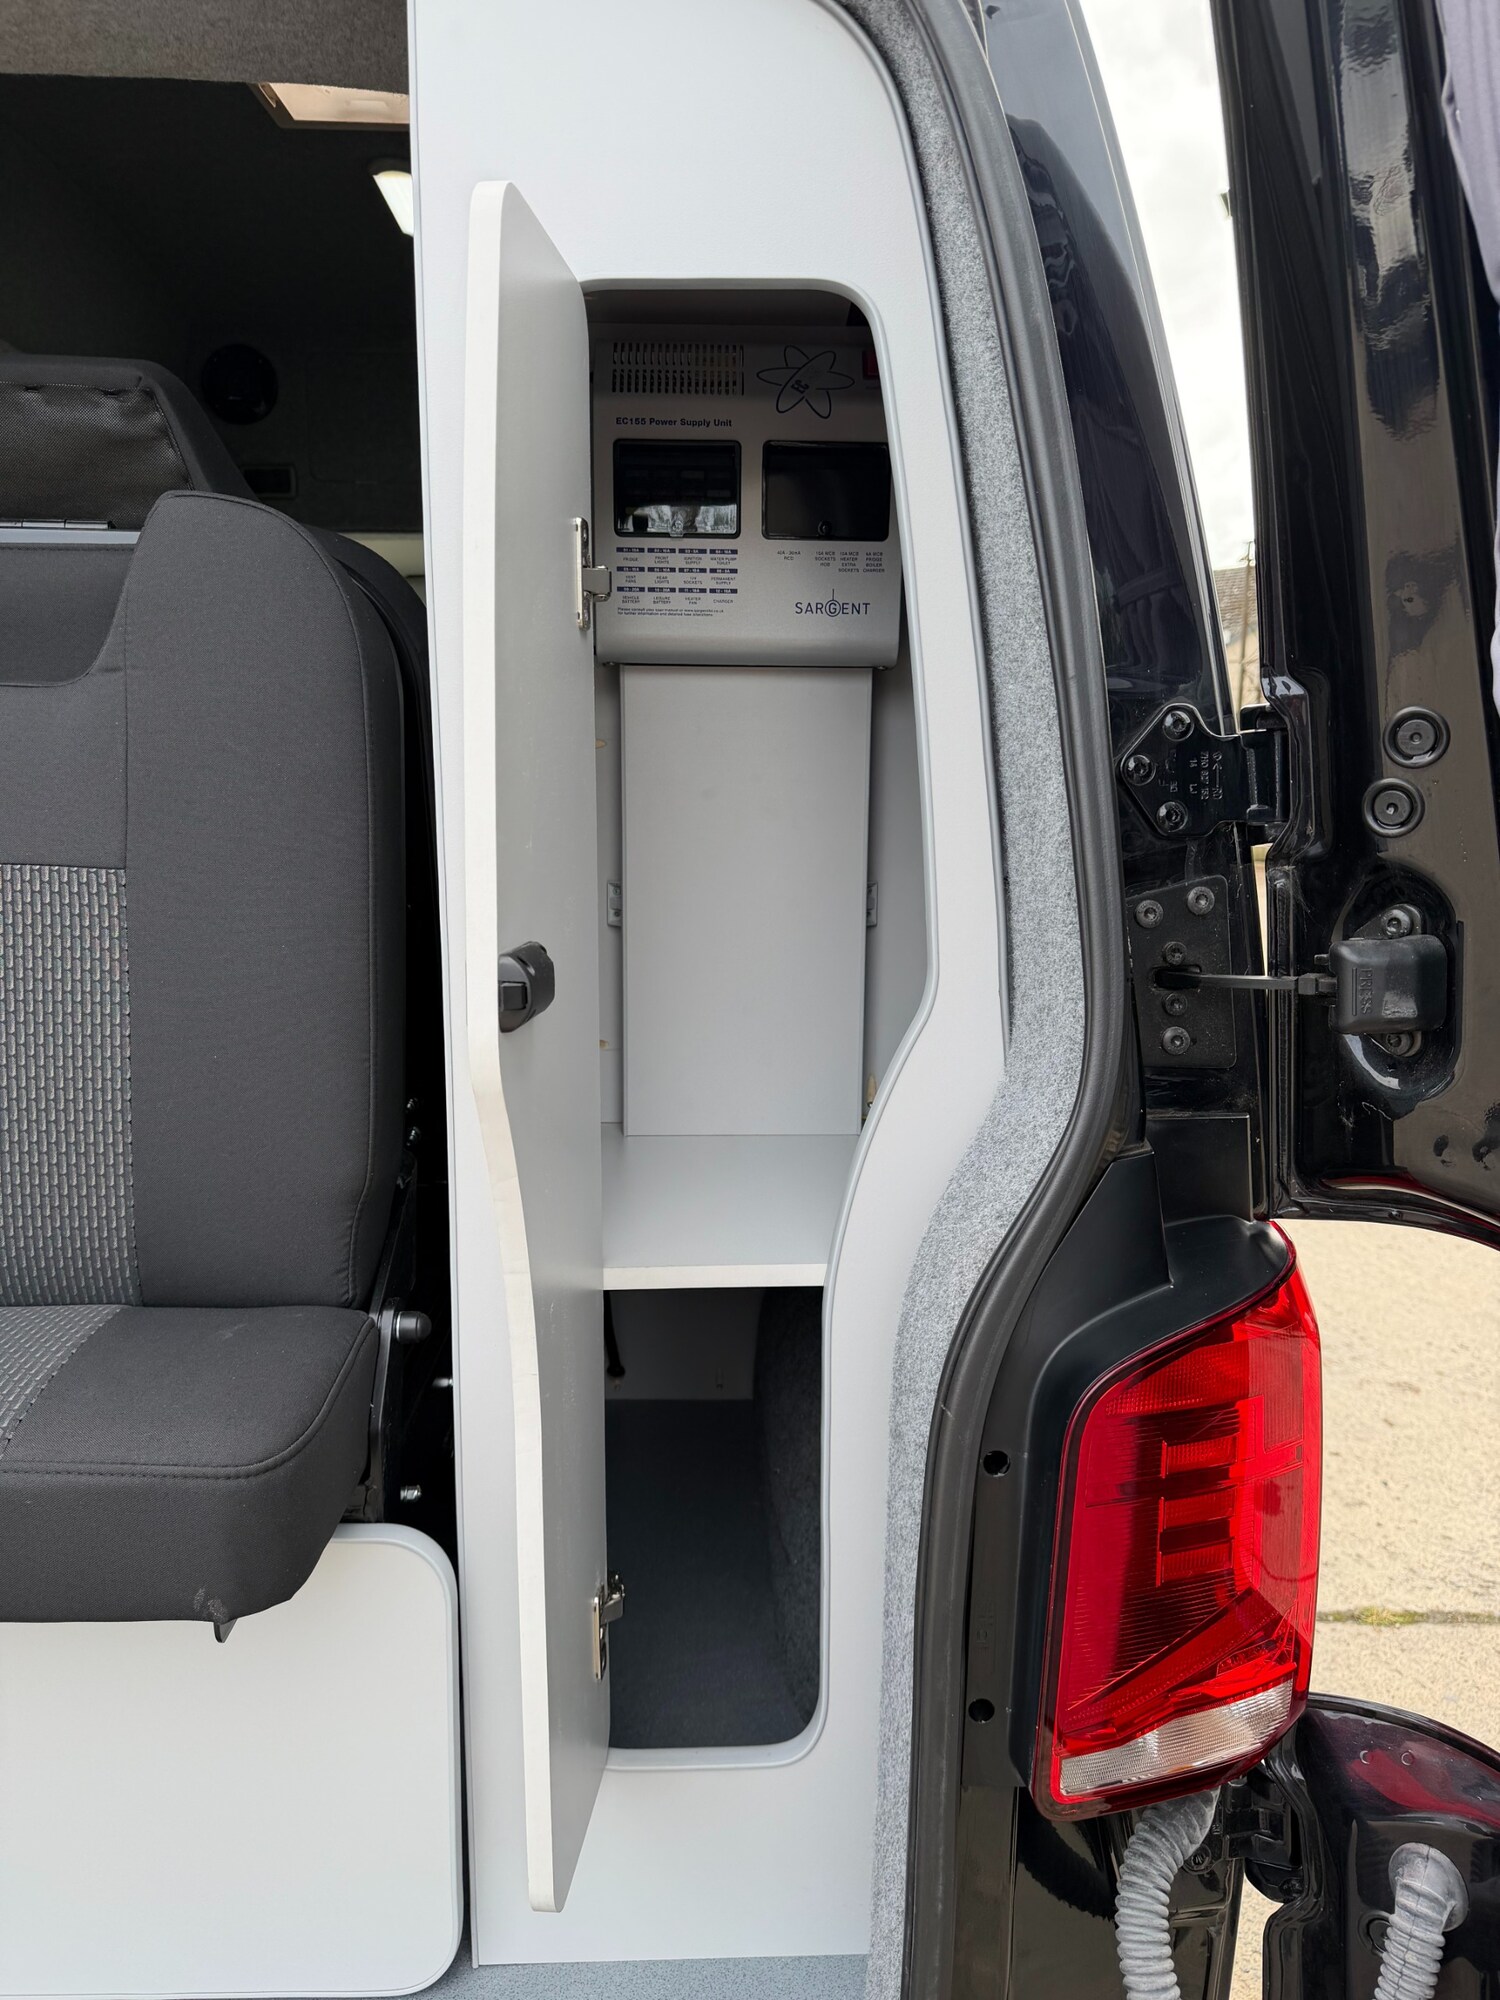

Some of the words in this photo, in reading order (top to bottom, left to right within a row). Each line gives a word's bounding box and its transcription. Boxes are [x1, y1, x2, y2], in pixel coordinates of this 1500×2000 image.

[616, 417, 646, 426] EC155
[649, 418, 677, 426] Power
[680, 418, 711, 428] Supply
[714, 419, 732, 427] Unit
[795, 600, 870, 617] SARGENT
[1360, 968, 1374, 1014] PRESS
